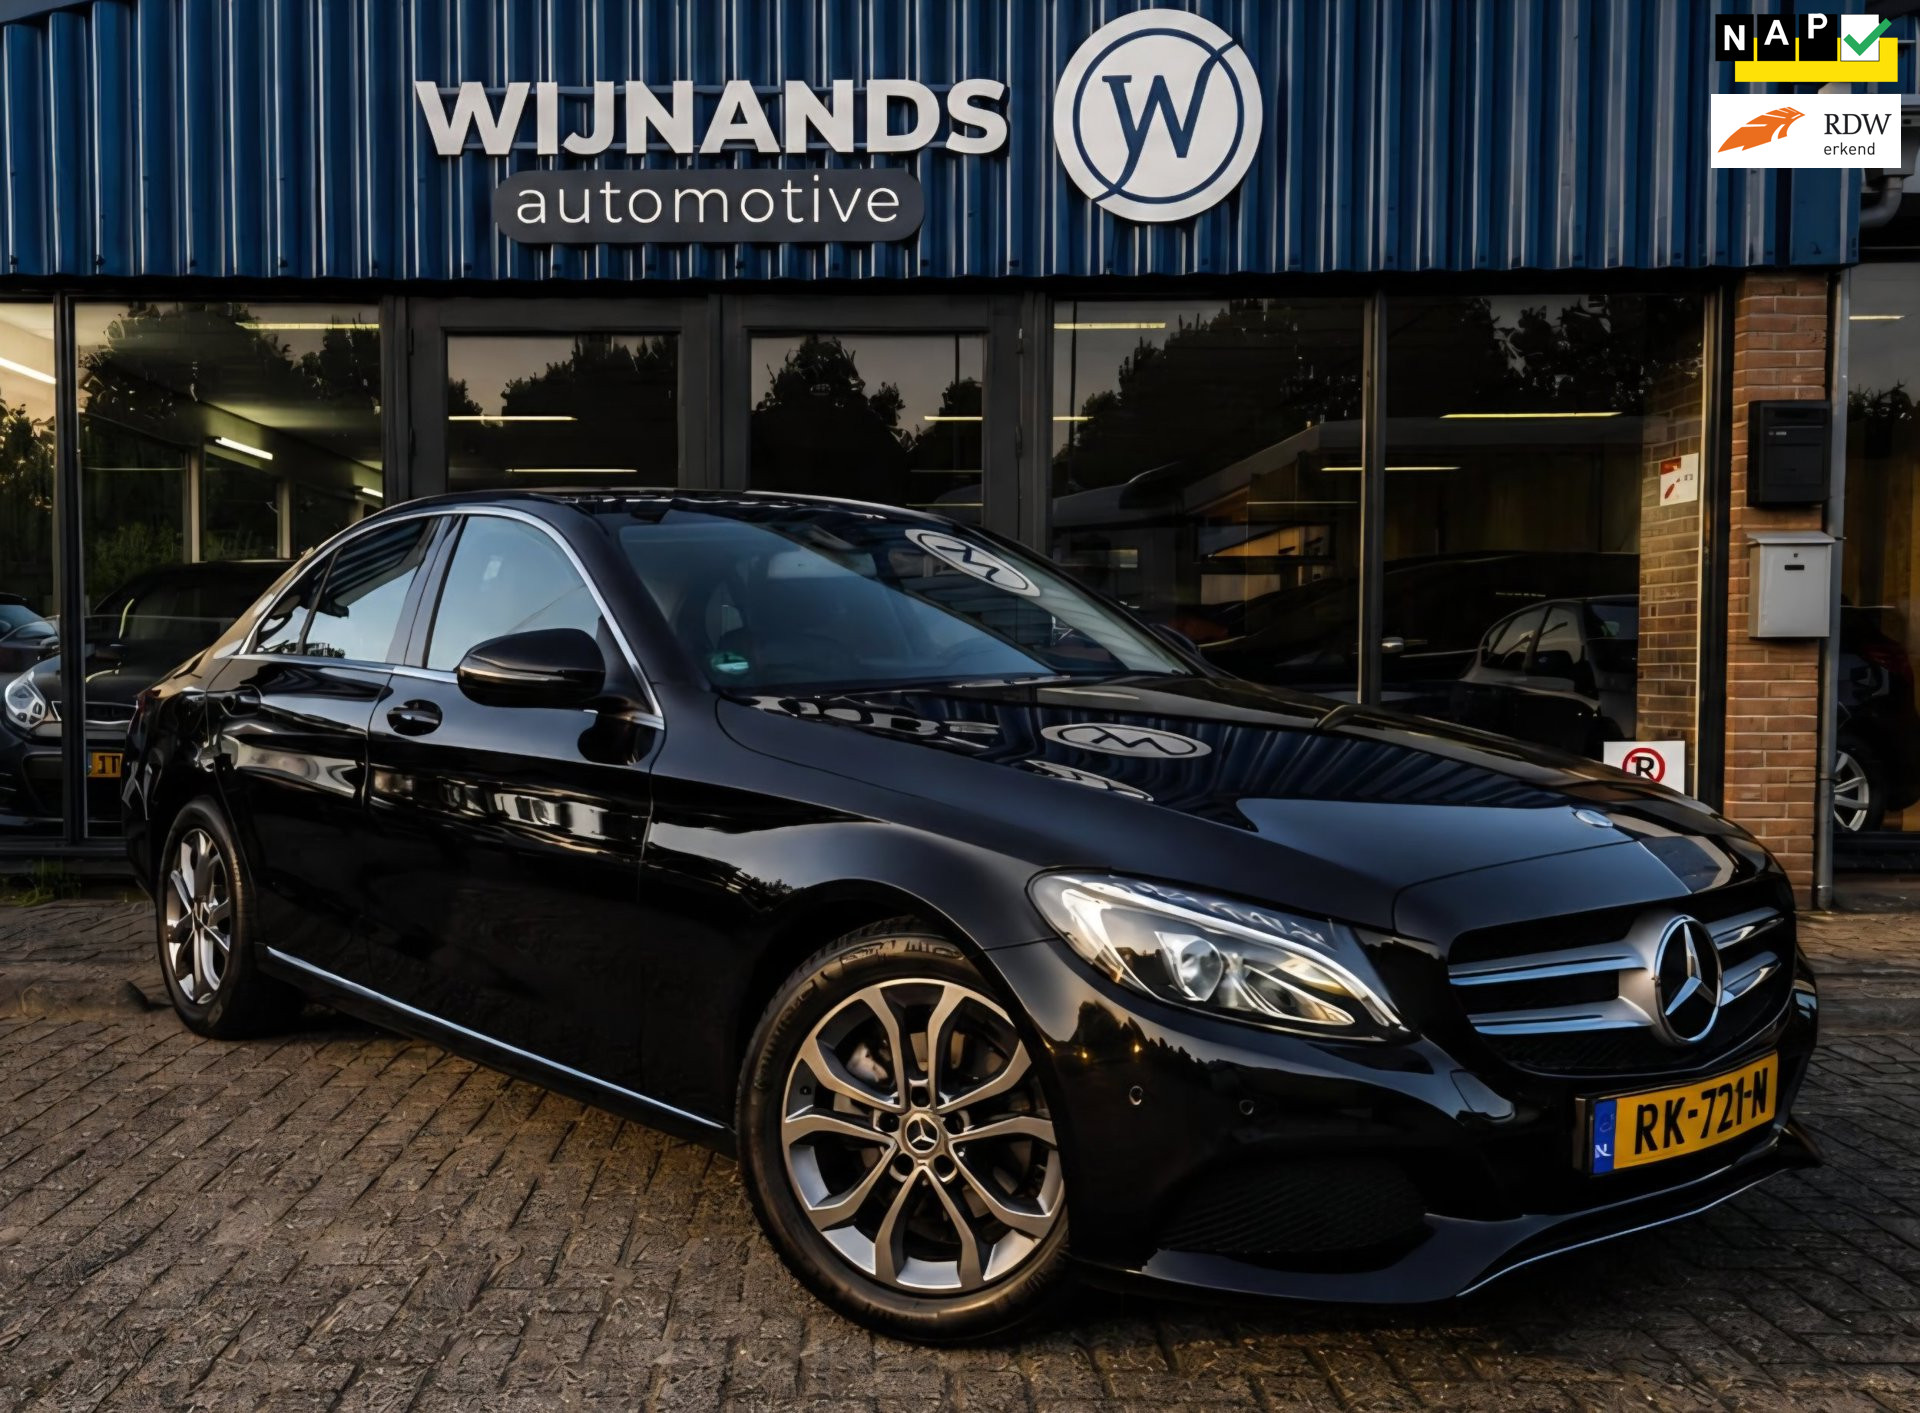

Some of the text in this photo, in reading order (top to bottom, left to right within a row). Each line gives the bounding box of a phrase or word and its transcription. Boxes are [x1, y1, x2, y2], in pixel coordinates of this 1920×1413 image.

[416, 79, 1009, 155] WIJNANDS
[516, 174, 900, 224] automotive
[1634, 1067, 1768, 1154] RK-721-N
